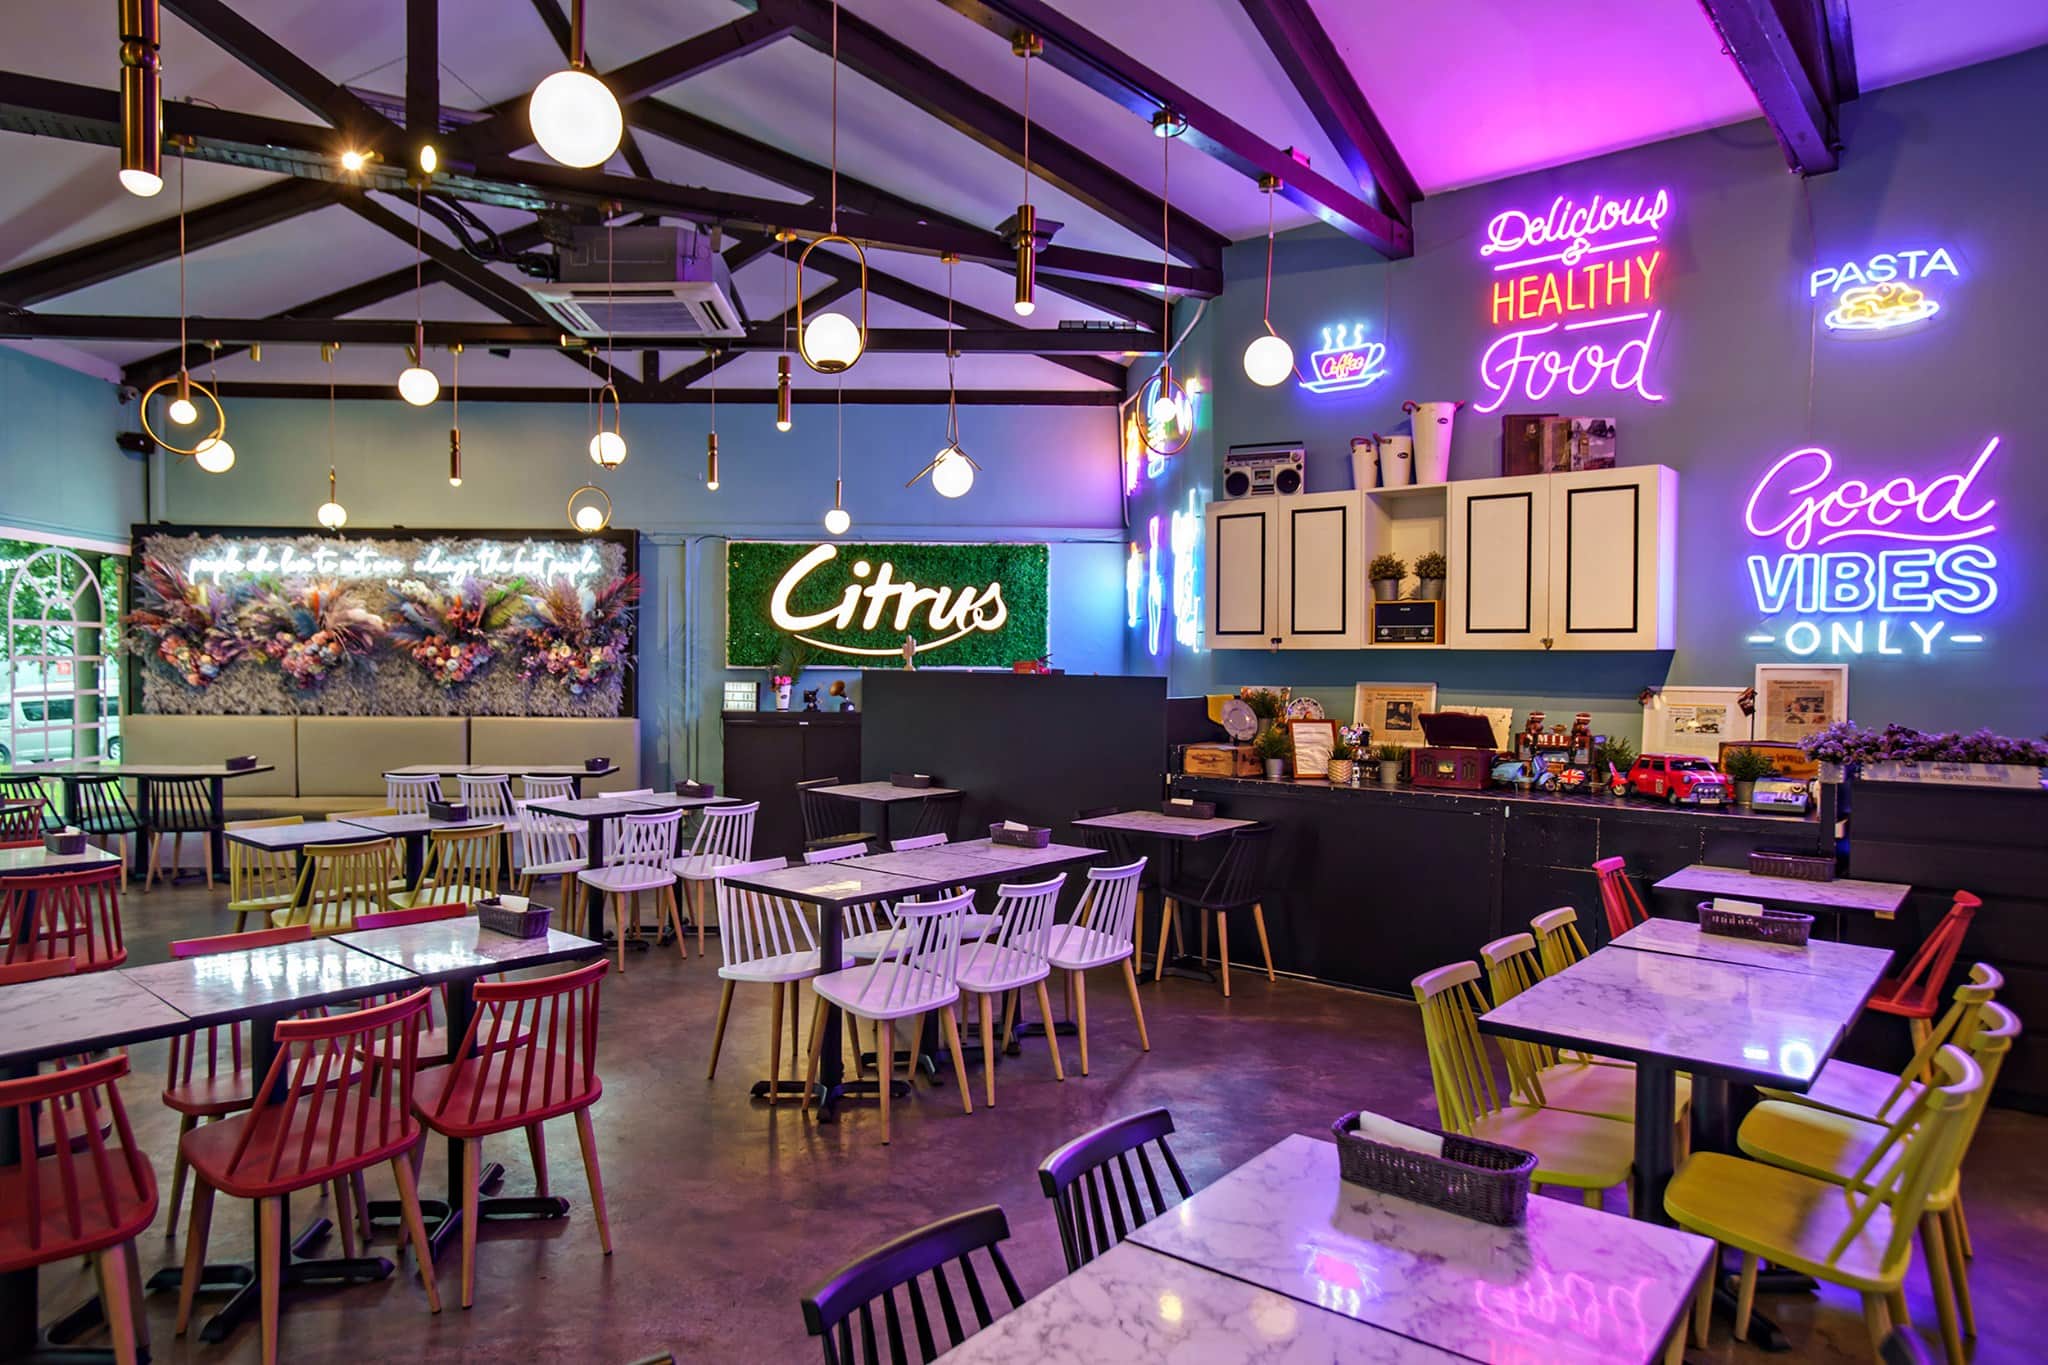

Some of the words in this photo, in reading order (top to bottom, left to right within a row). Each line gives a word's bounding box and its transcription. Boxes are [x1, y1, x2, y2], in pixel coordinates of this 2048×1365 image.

[1480, 189, 1669, 256] Delicious
[1561, 237, 1591, 266] &
[1492, 250, 1661, 325] HEALTHY
[1810, 247, 1960, 298] PASTA
[1321, 351, 1365, 380] Coffee
[1473, 309, 1664, 413] Food
[1745, 435, 2000, 551] Good
[770, 543, 1008, 634] Citrus
[1747, 543, 1999, 615] VIBES
